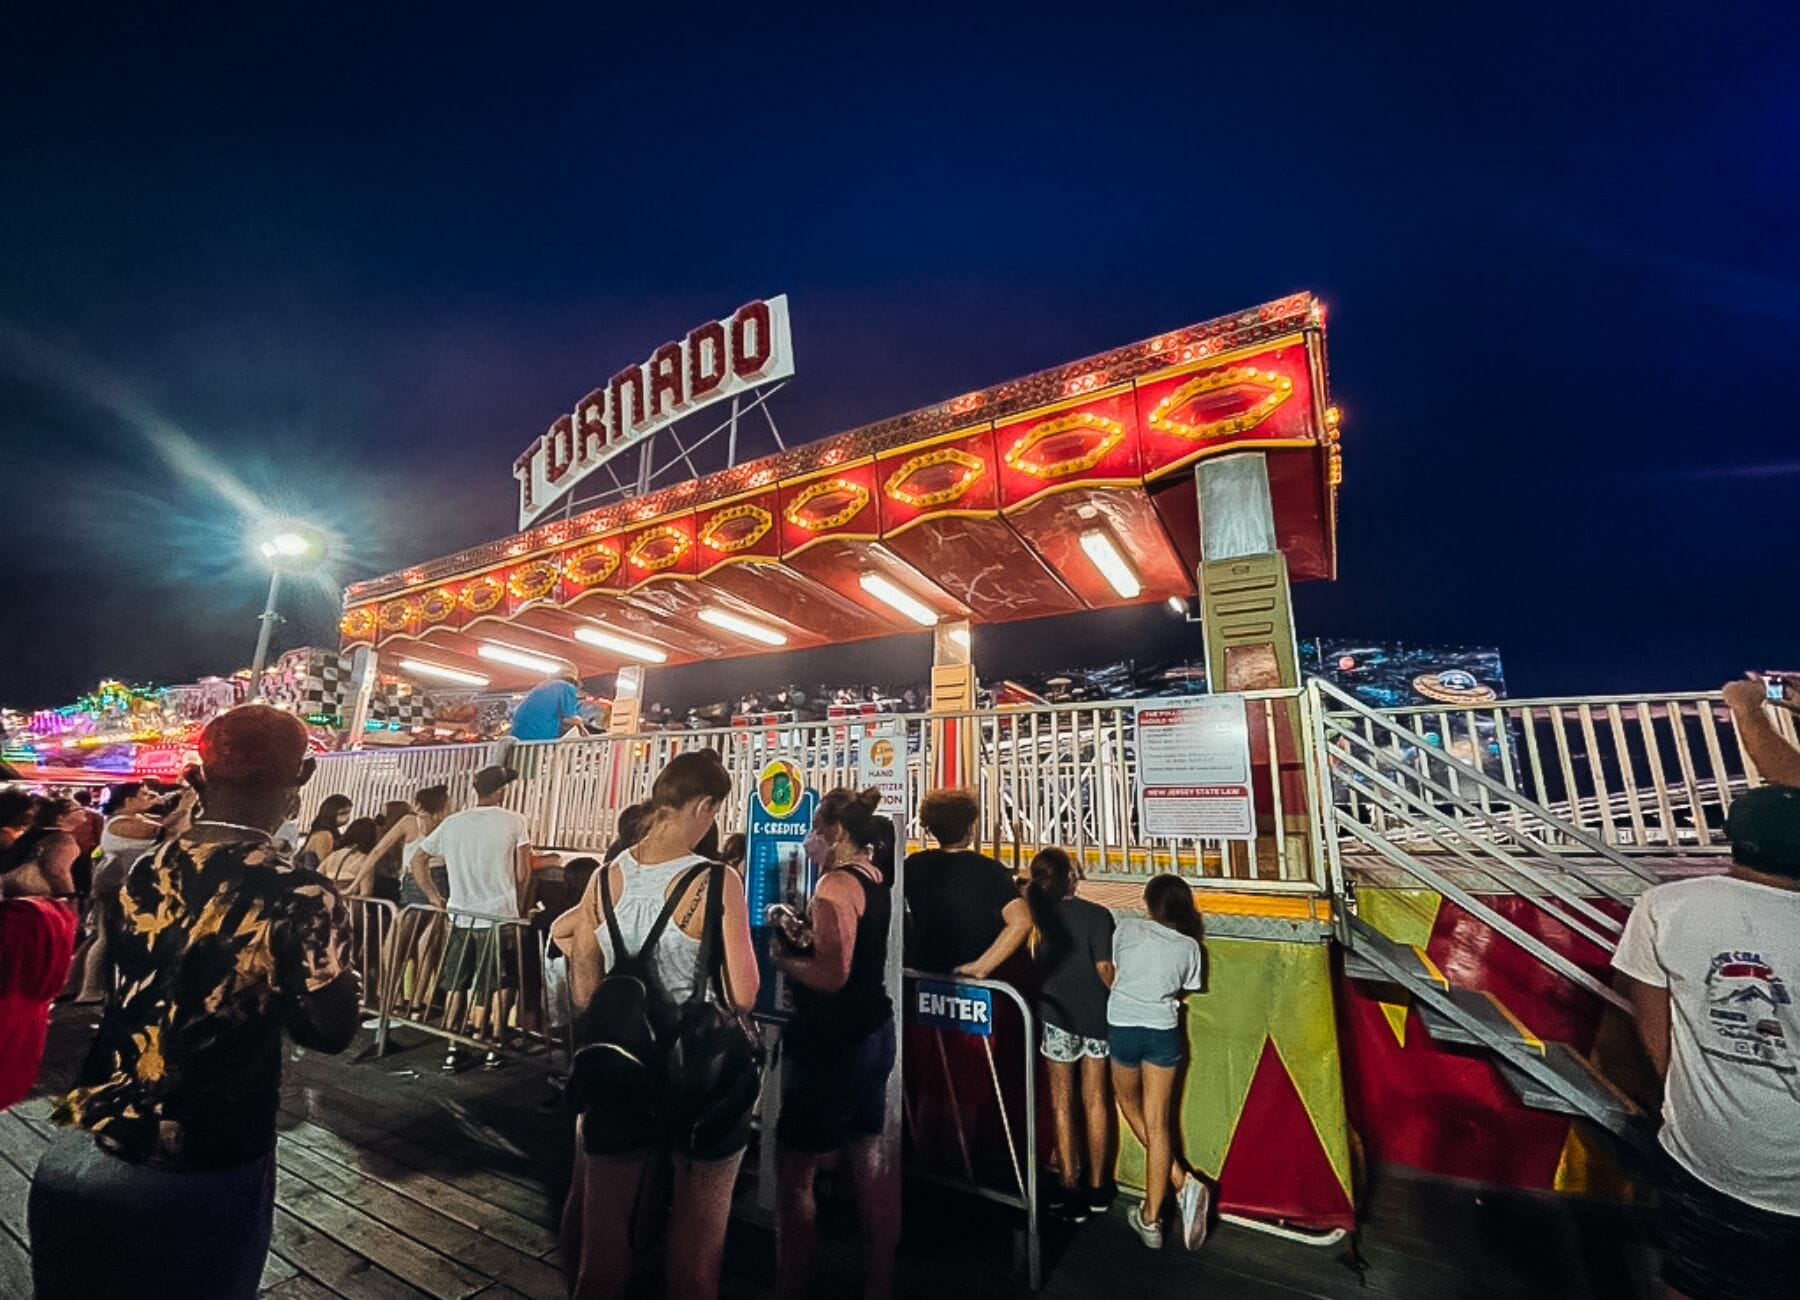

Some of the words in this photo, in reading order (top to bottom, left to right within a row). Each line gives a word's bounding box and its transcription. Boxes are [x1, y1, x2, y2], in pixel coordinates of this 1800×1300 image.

[514, 298, 776, 512] TORNADO
[868, 769, 894, 777] HAND
[1195, 788, 1219, 796] STATE
[918, 992, 988, 1024] ENTER
